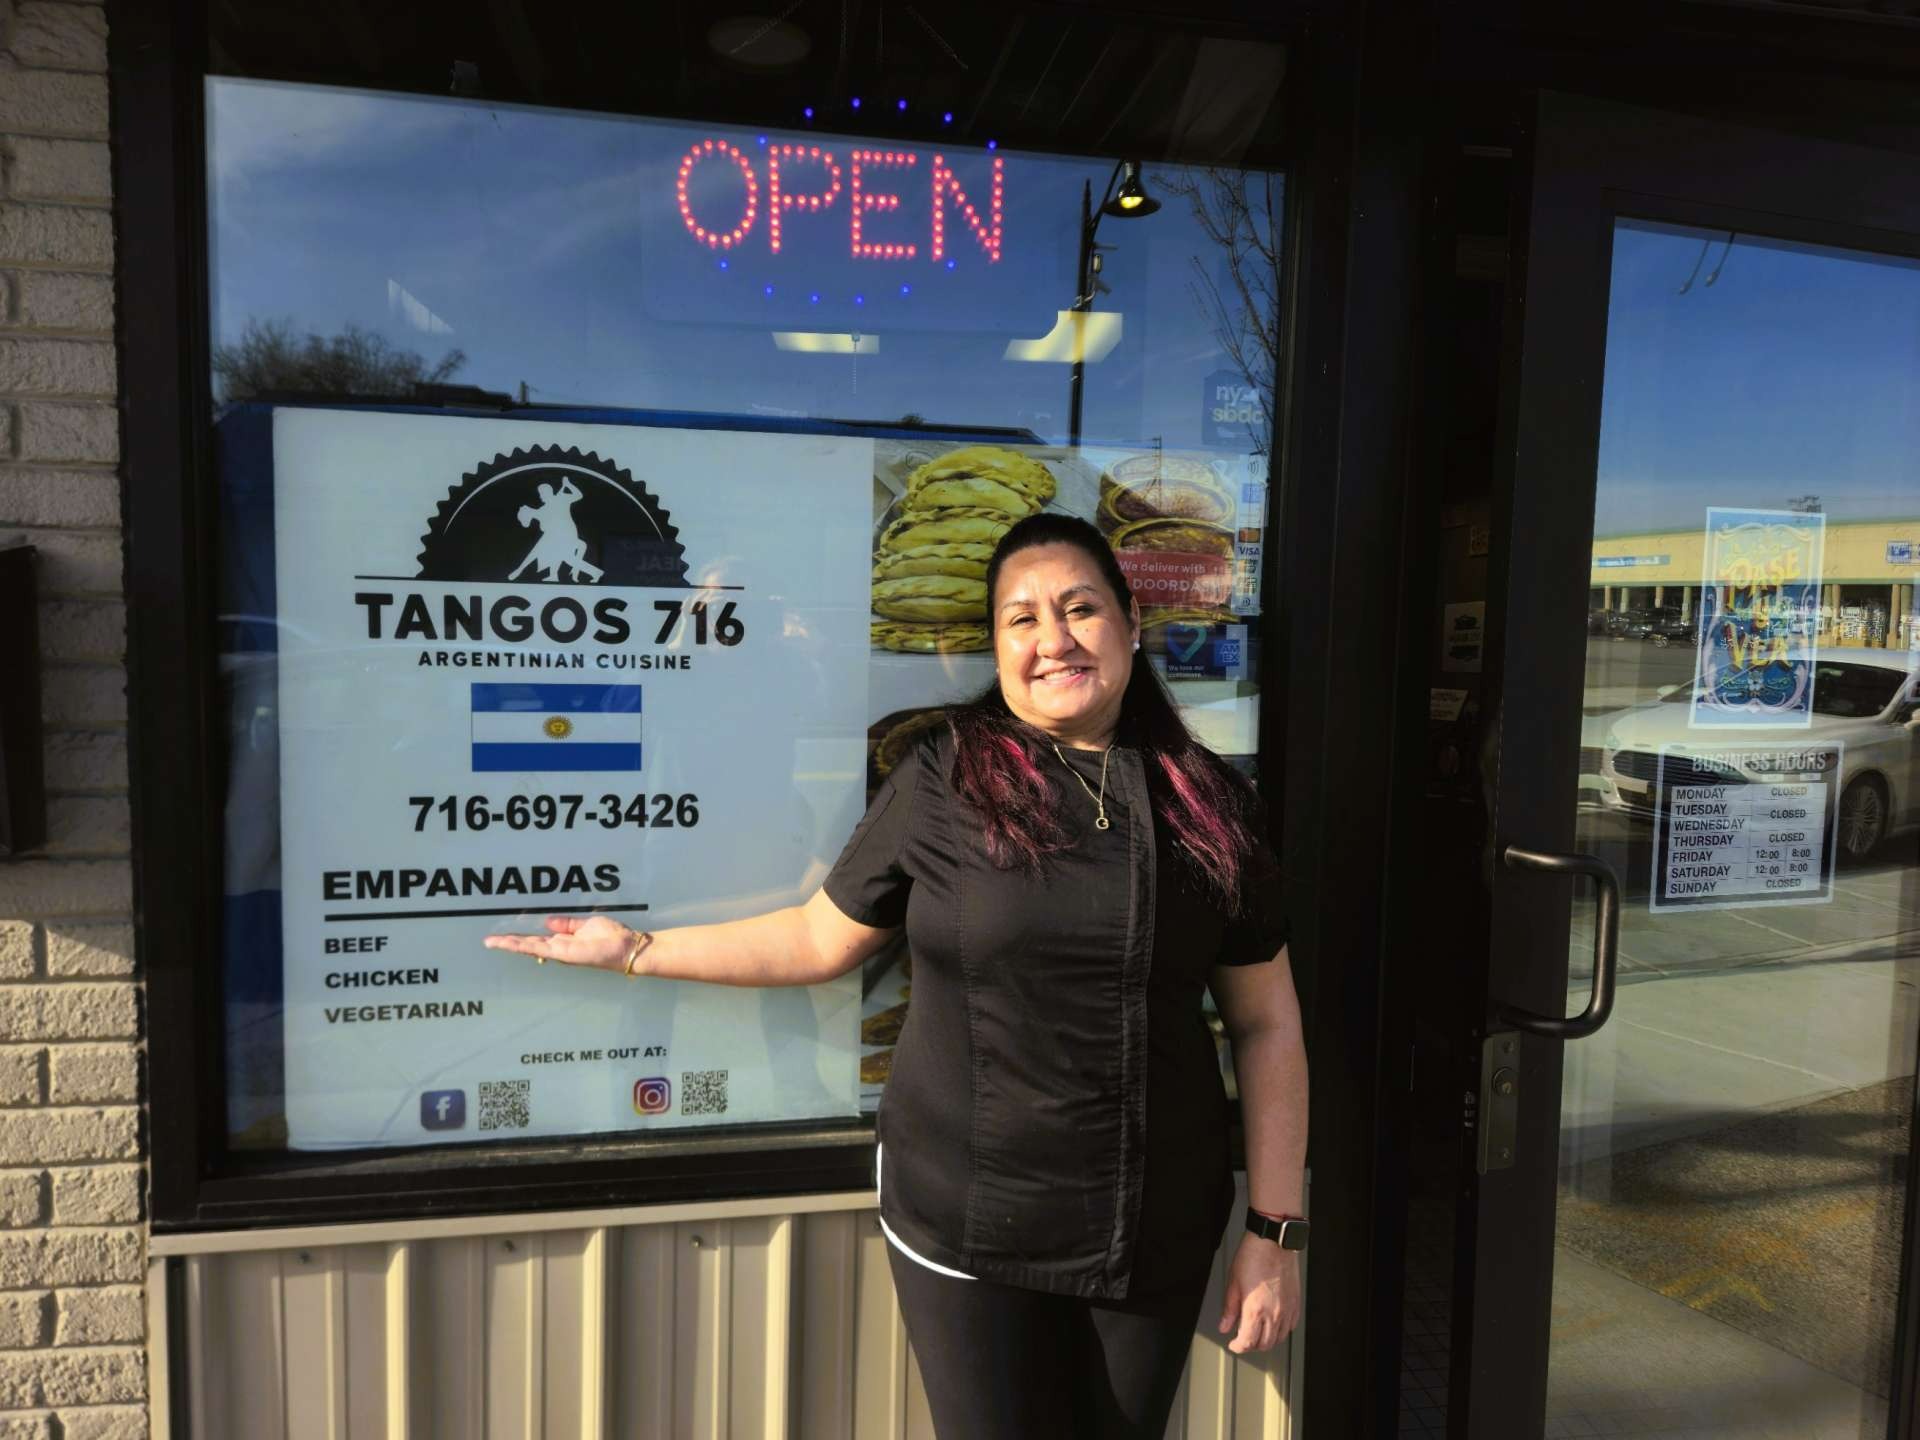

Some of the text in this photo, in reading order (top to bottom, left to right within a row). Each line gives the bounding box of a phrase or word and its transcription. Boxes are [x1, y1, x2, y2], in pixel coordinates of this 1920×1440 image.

[678, 140, 1004, 263] OPEN
[1238, 546, 1261, 555] VISA
[1119, 560, 1206, 574] We deliver with
[354, 592, 745, 647] TANGOS 716
[418, 650, 692, 670] ARGENTINIAN CUISINE
[1692, 751, 1827, 772] BUSINESS HOURS
[1676, 786, 1808, 800] MONDAY CLOSED
[408, 793, 700, 832] 716-697-3426
[1675, 803, 1806, 819] TUESDAY CLOSED
[1674, 818, 1745, 832] WEDNESDAY
[1673, 832, 1805, 847] THURSDAY CLOSED
[1672, 851, 1713, 863] FRIDAY
[1791, 849, 1811, 858] 8:00
[1671, 865, 1731, 879] SATURDAY
[1789, 863, 1808, 873] 8:00
[322, 864, 621, 900] EMPANADAS
[1670, 878, 1802, 894] SUNDAY CLOSED
[324, 936, 389, 954] BEEF
[324, 968, 440, 989] CHICKEN
[324, 1001, 484, 1024] VEGETARIAN
[520, 1046, 668, 1065] CHECK ME OUT AT:
